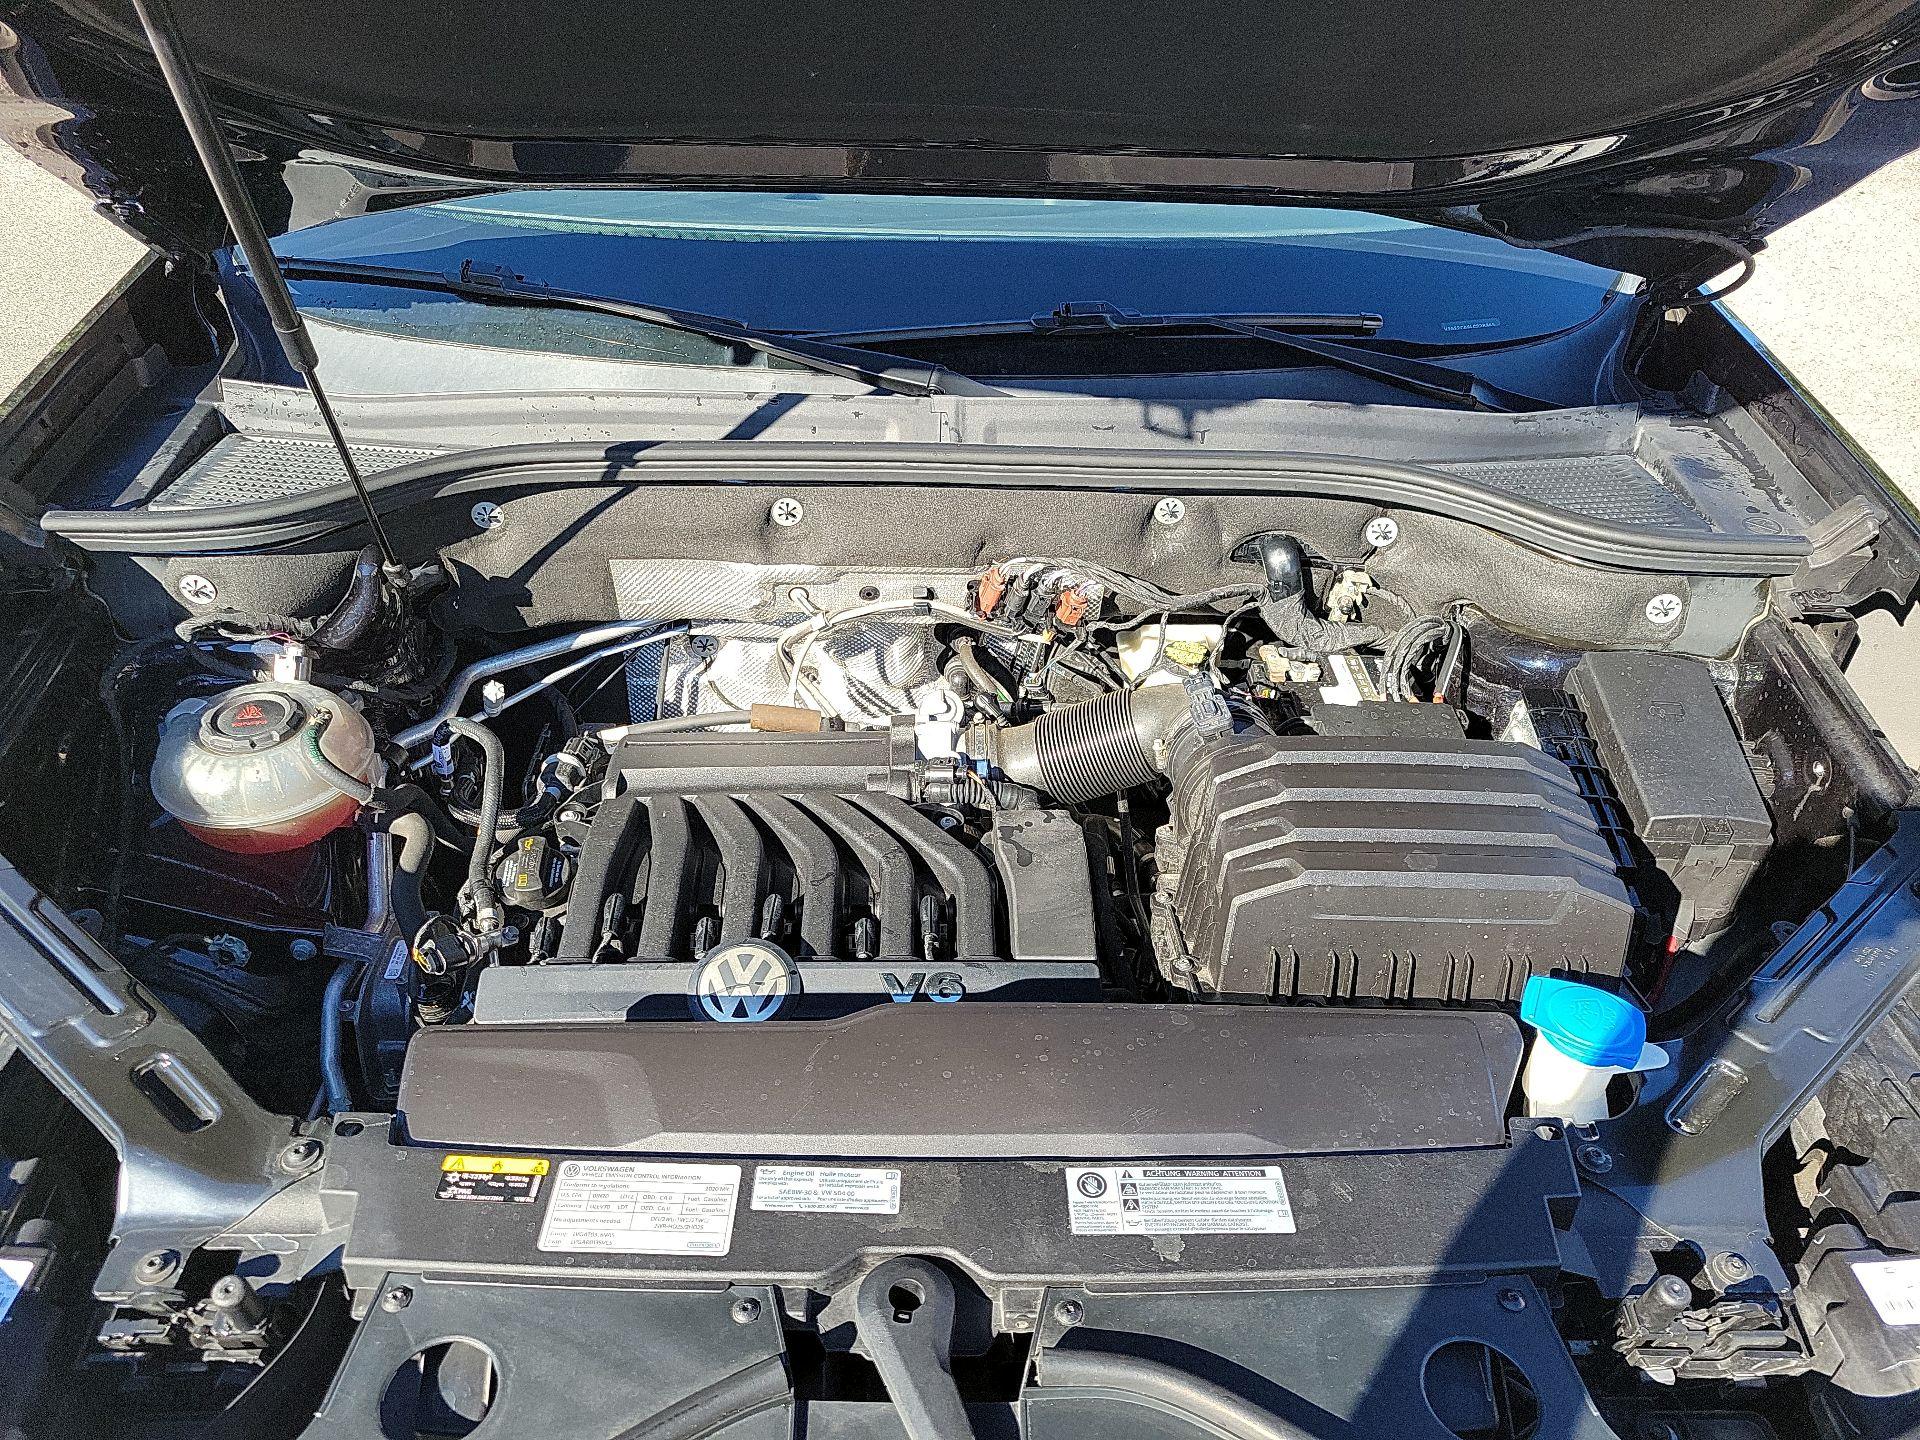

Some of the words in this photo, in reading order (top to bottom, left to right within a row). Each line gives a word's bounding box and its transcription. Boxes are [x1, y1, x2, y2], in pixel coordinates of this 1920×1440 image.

[879, 972, 967, 1003] V6
[583, 1165, 635, 1173] VOLKSWAGEN
[1145, 1169, 1181, 1177] ACHTUNG
